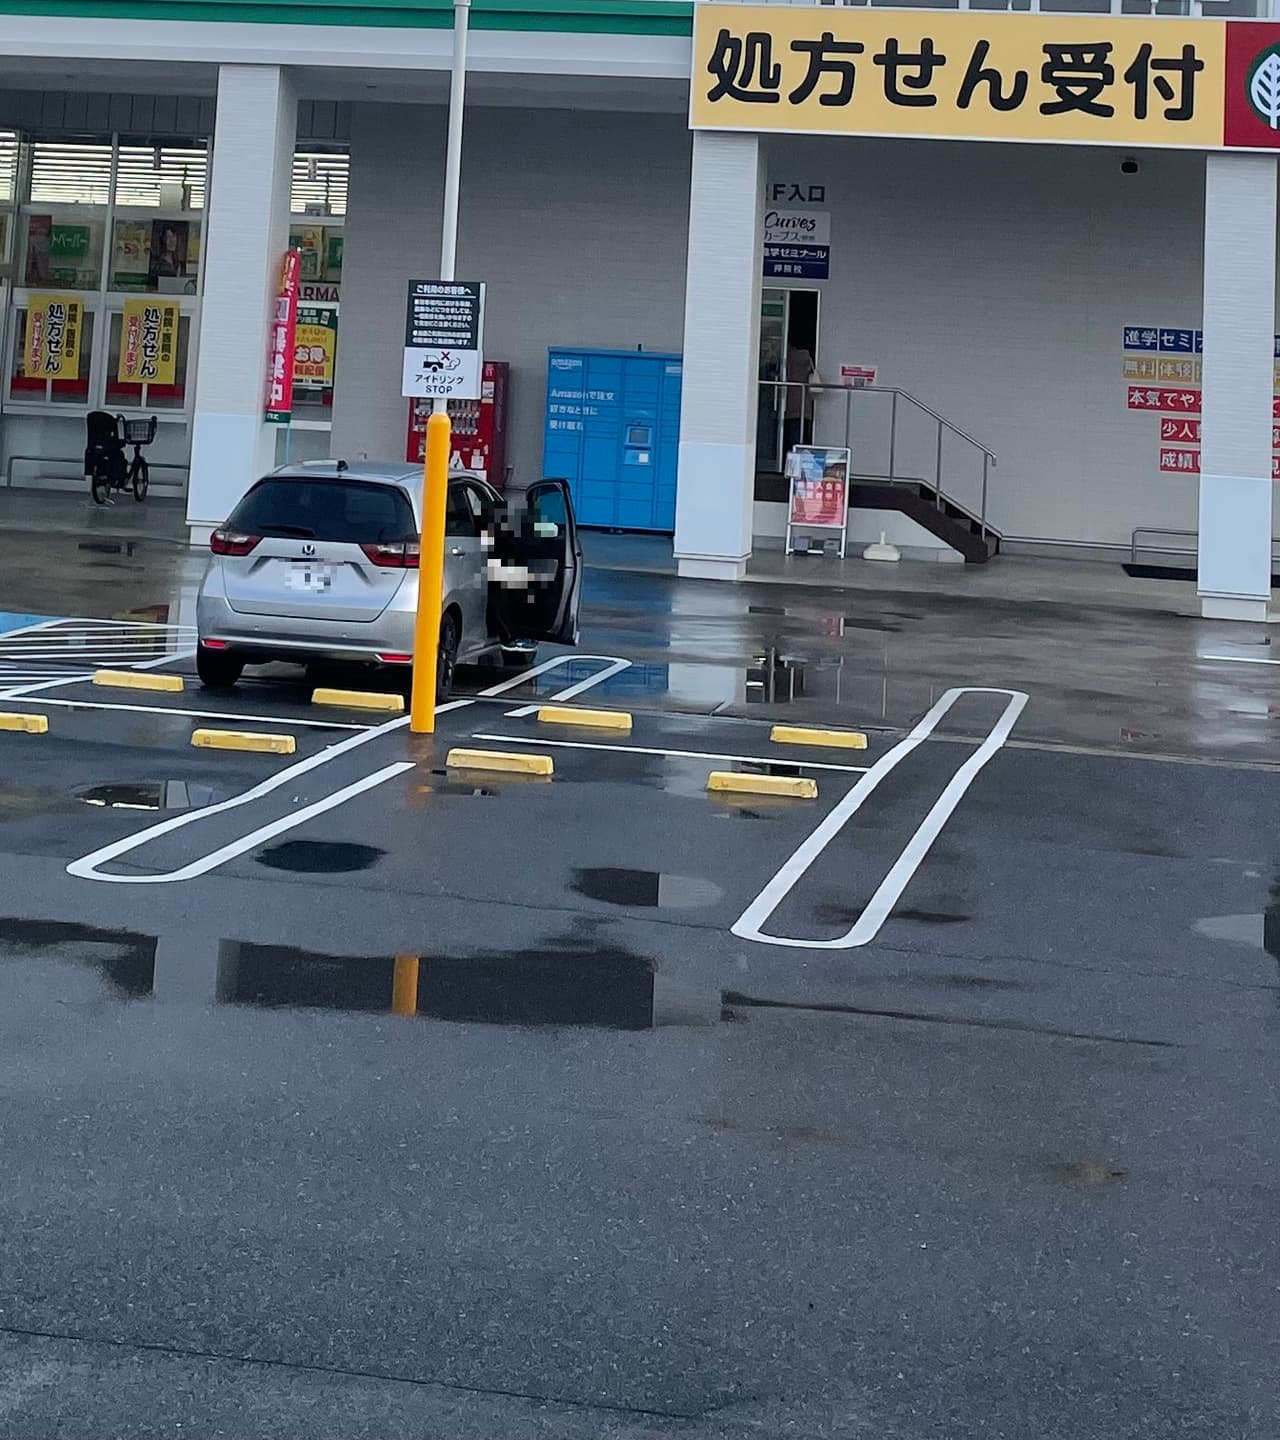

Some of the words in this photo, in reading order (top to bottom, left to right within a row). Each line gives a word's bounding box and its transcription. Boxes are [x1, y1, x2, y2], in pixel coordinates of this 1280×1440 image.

[707, 28, 1204, 121] 処方せん受付
[766, 183, 826, 203] F入口
[764, 211, 817, 232] Curves
[45, 303, 64, 373] 処方せん
[140, 307, 161, 378] 処方せん
[415, 374, 464, 384] アイドリング
[425, 385, 453, 394] STOP
